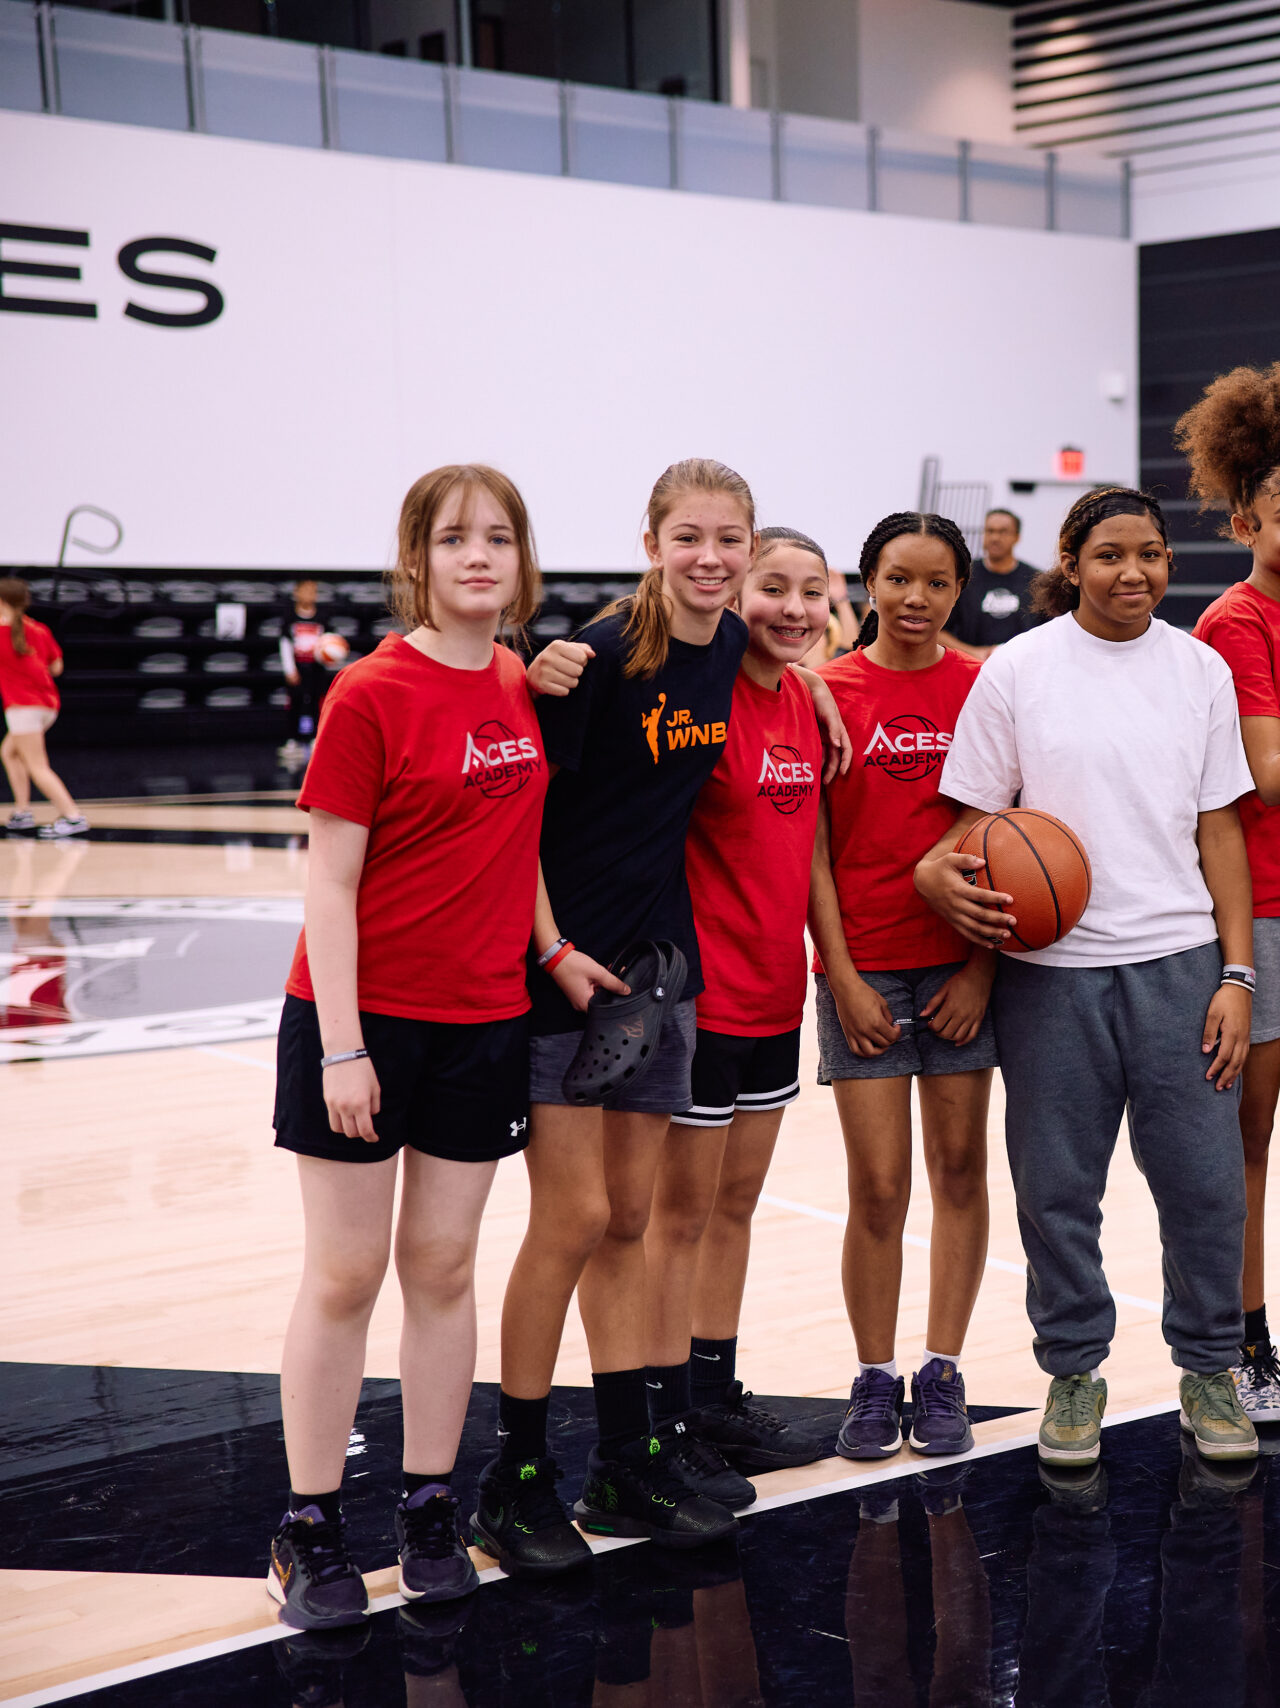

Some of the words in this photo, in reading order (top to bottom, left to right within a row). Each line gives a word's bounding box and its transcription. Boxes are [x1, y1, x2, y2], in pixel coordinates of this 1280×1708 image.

[666, 708, 694, 728] JR.
[666, 721, 727, 751] WNB
[863, 721, 954, 756] ACES
[461, 731, 539, 775] ACES
[757, 747, 815, 784] ACES
[463, 759, 542, 790] ACADEMY
[757, 784, 815, 798] ACADEMY
